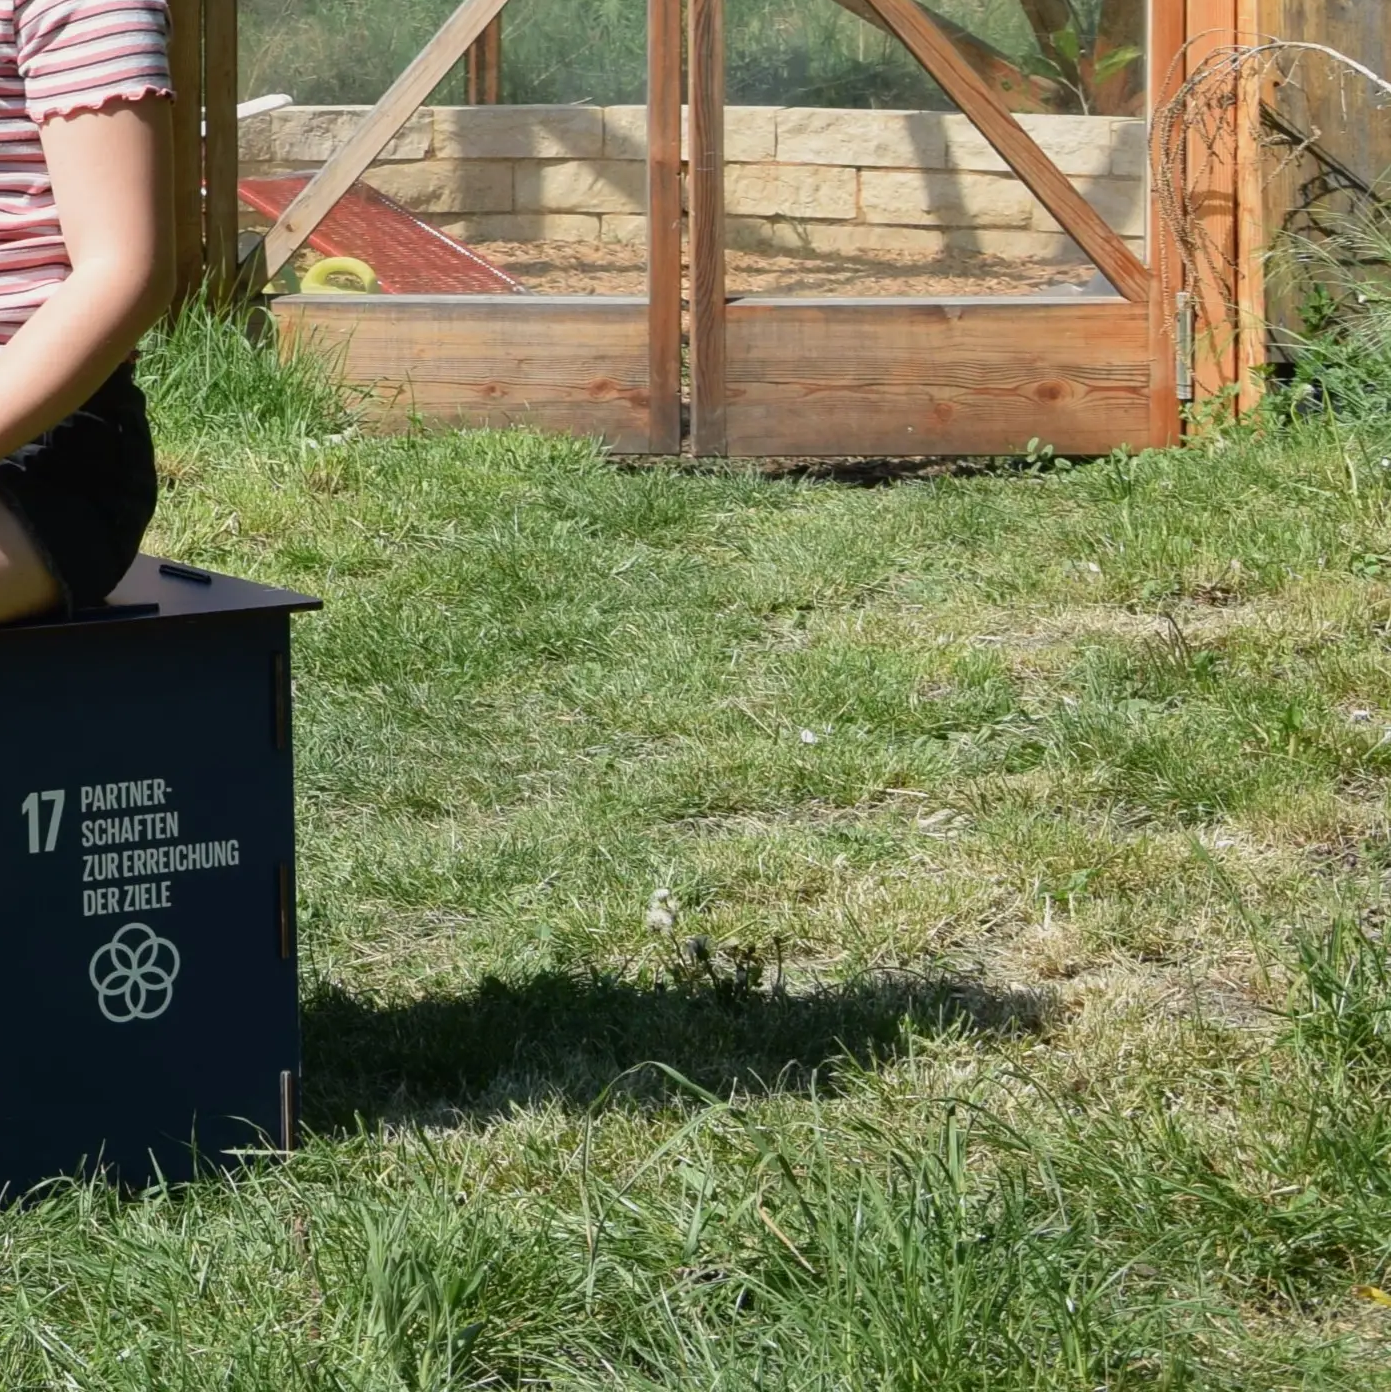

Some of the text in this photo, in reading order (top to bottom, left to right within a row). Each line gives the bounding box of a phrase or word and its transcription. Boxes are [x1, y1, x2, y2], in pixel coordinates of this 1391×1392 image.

[80, 778, 173, 813] PARTNER-
[21, 788, 66, 854] 17
[81, 811, 180, 848] SCHAFTEN
[82, 839, 240, 882] ZUR ERREICHUNG
[83, 880, 172, 917] DER ZIELE
